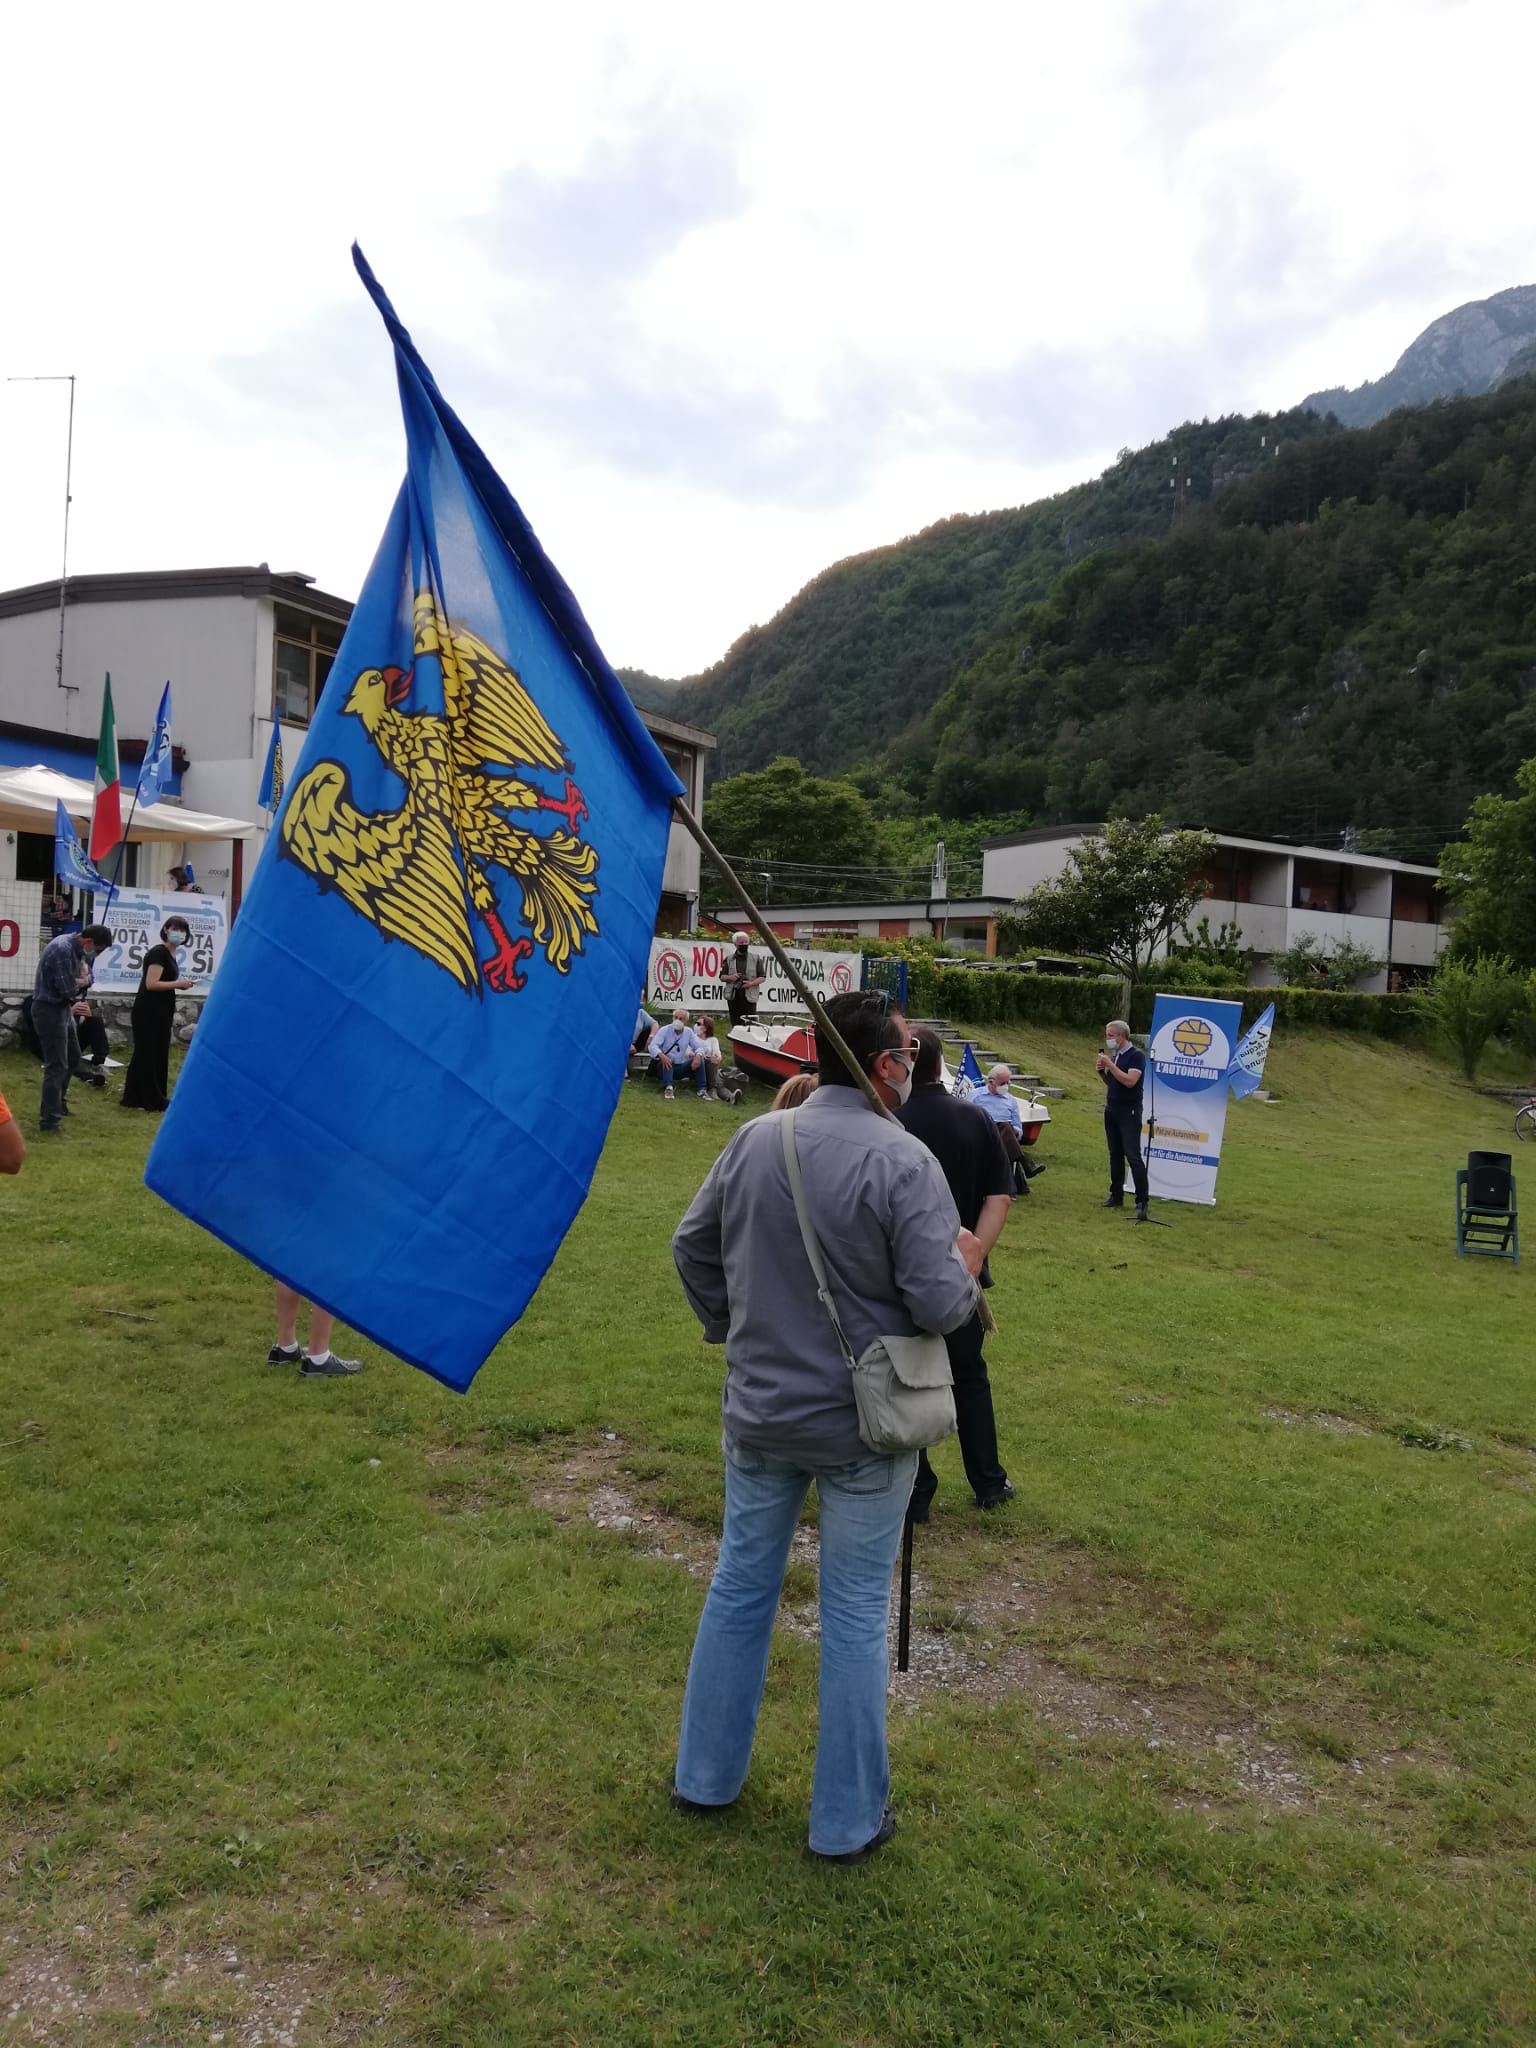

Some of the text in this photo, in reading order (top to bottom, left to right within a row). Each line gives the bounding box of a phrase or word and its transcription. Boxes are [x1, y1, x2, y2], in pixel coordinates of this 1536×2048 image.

[184, 934, 214, 950] OTA
[107, 944, 123, 969] 2
[191, 949, 214, 974] Sì
[767, 987, 826, 1005] CIMPEO
[1174, 1056, 1192, 1064] PATTO
[1156, 1062, 1218, 1080] L'AUTONOMIA
